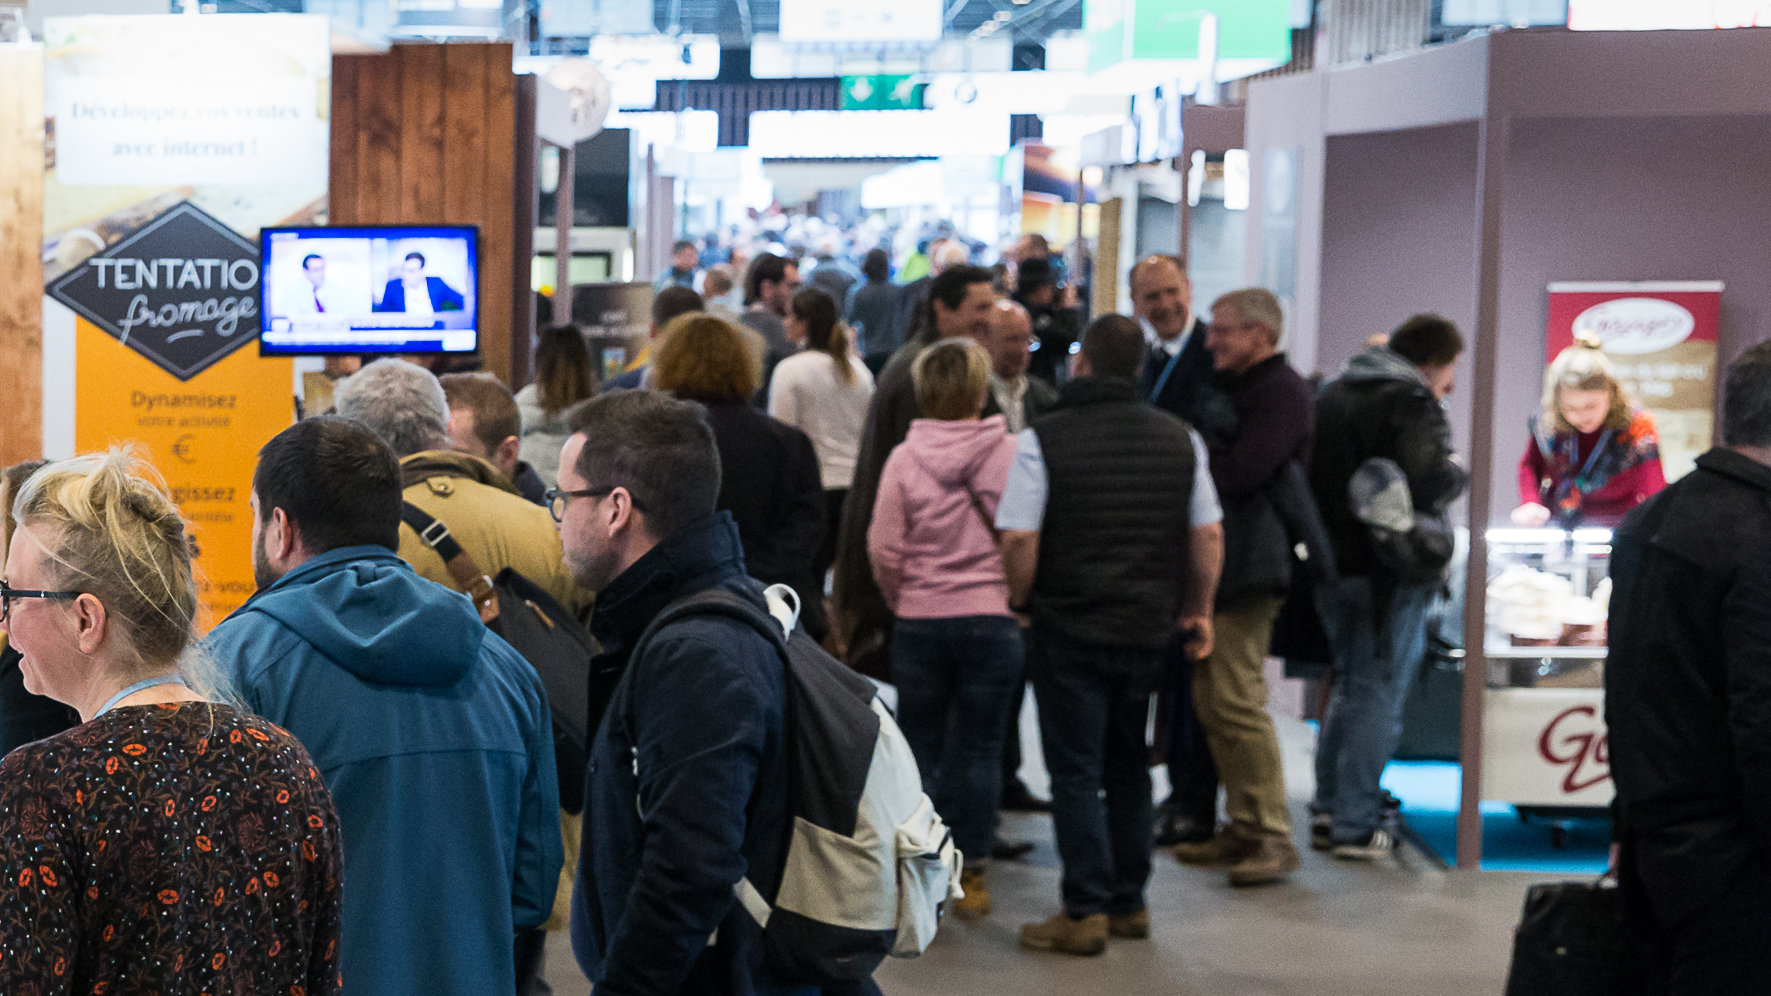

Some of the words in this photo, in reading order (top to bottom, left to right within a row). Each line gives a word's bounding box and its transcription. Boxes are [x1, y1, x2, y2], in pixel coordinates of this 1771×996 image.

[112, 142, 155, 157] avec
[162, 138, 245, 157] internet
[89, 257, 259, 291] TENTATIO
[117, 293, 259, 346] fromage
[130, 389, 237, 411] Dynamisez
[171, 482, 236, 506] gissez
